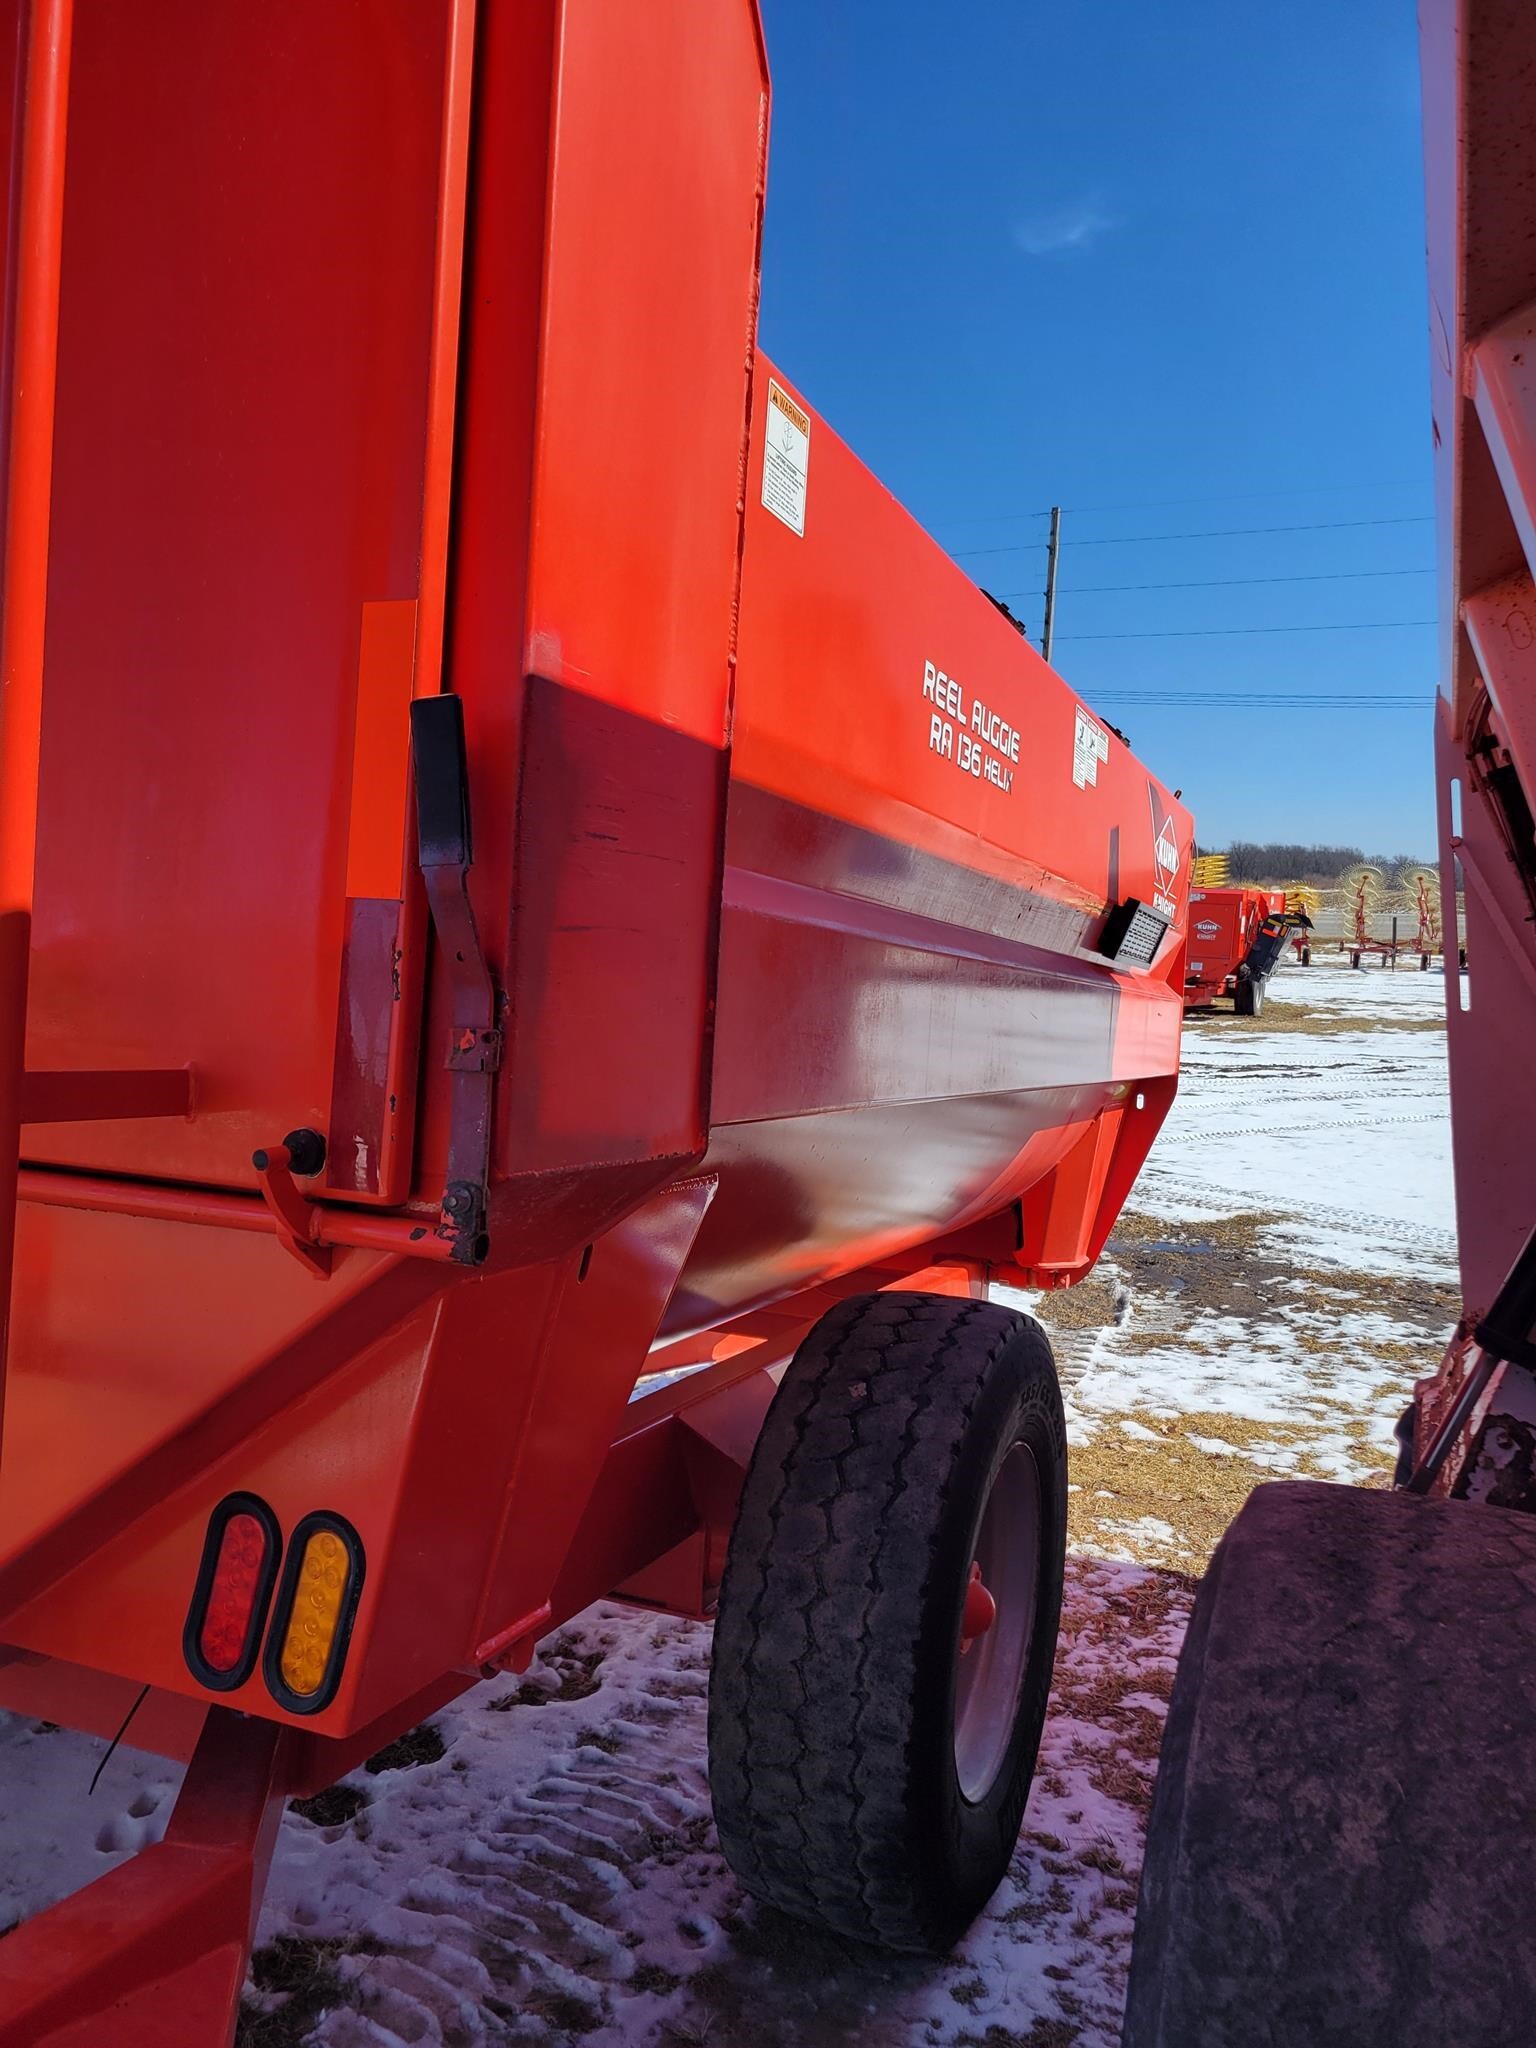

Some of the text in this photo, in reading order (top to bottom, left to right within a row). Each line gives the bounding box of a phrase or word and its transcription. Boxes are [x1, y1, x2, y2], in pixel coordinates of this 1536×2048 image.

[779, 395, 807, 433] WARNING
[923, 659, 967, 726] REEL
[971, 699, 1020, 764] AUGGIE
[929, 713, 953, 761] RA
[957, 732, 982, 778] 136
[1159, 836, 1177, 874] KUHN
[1153, 891, 1176, 921] KNIGHT
[1197, 923, 1217, 931] KUHN
